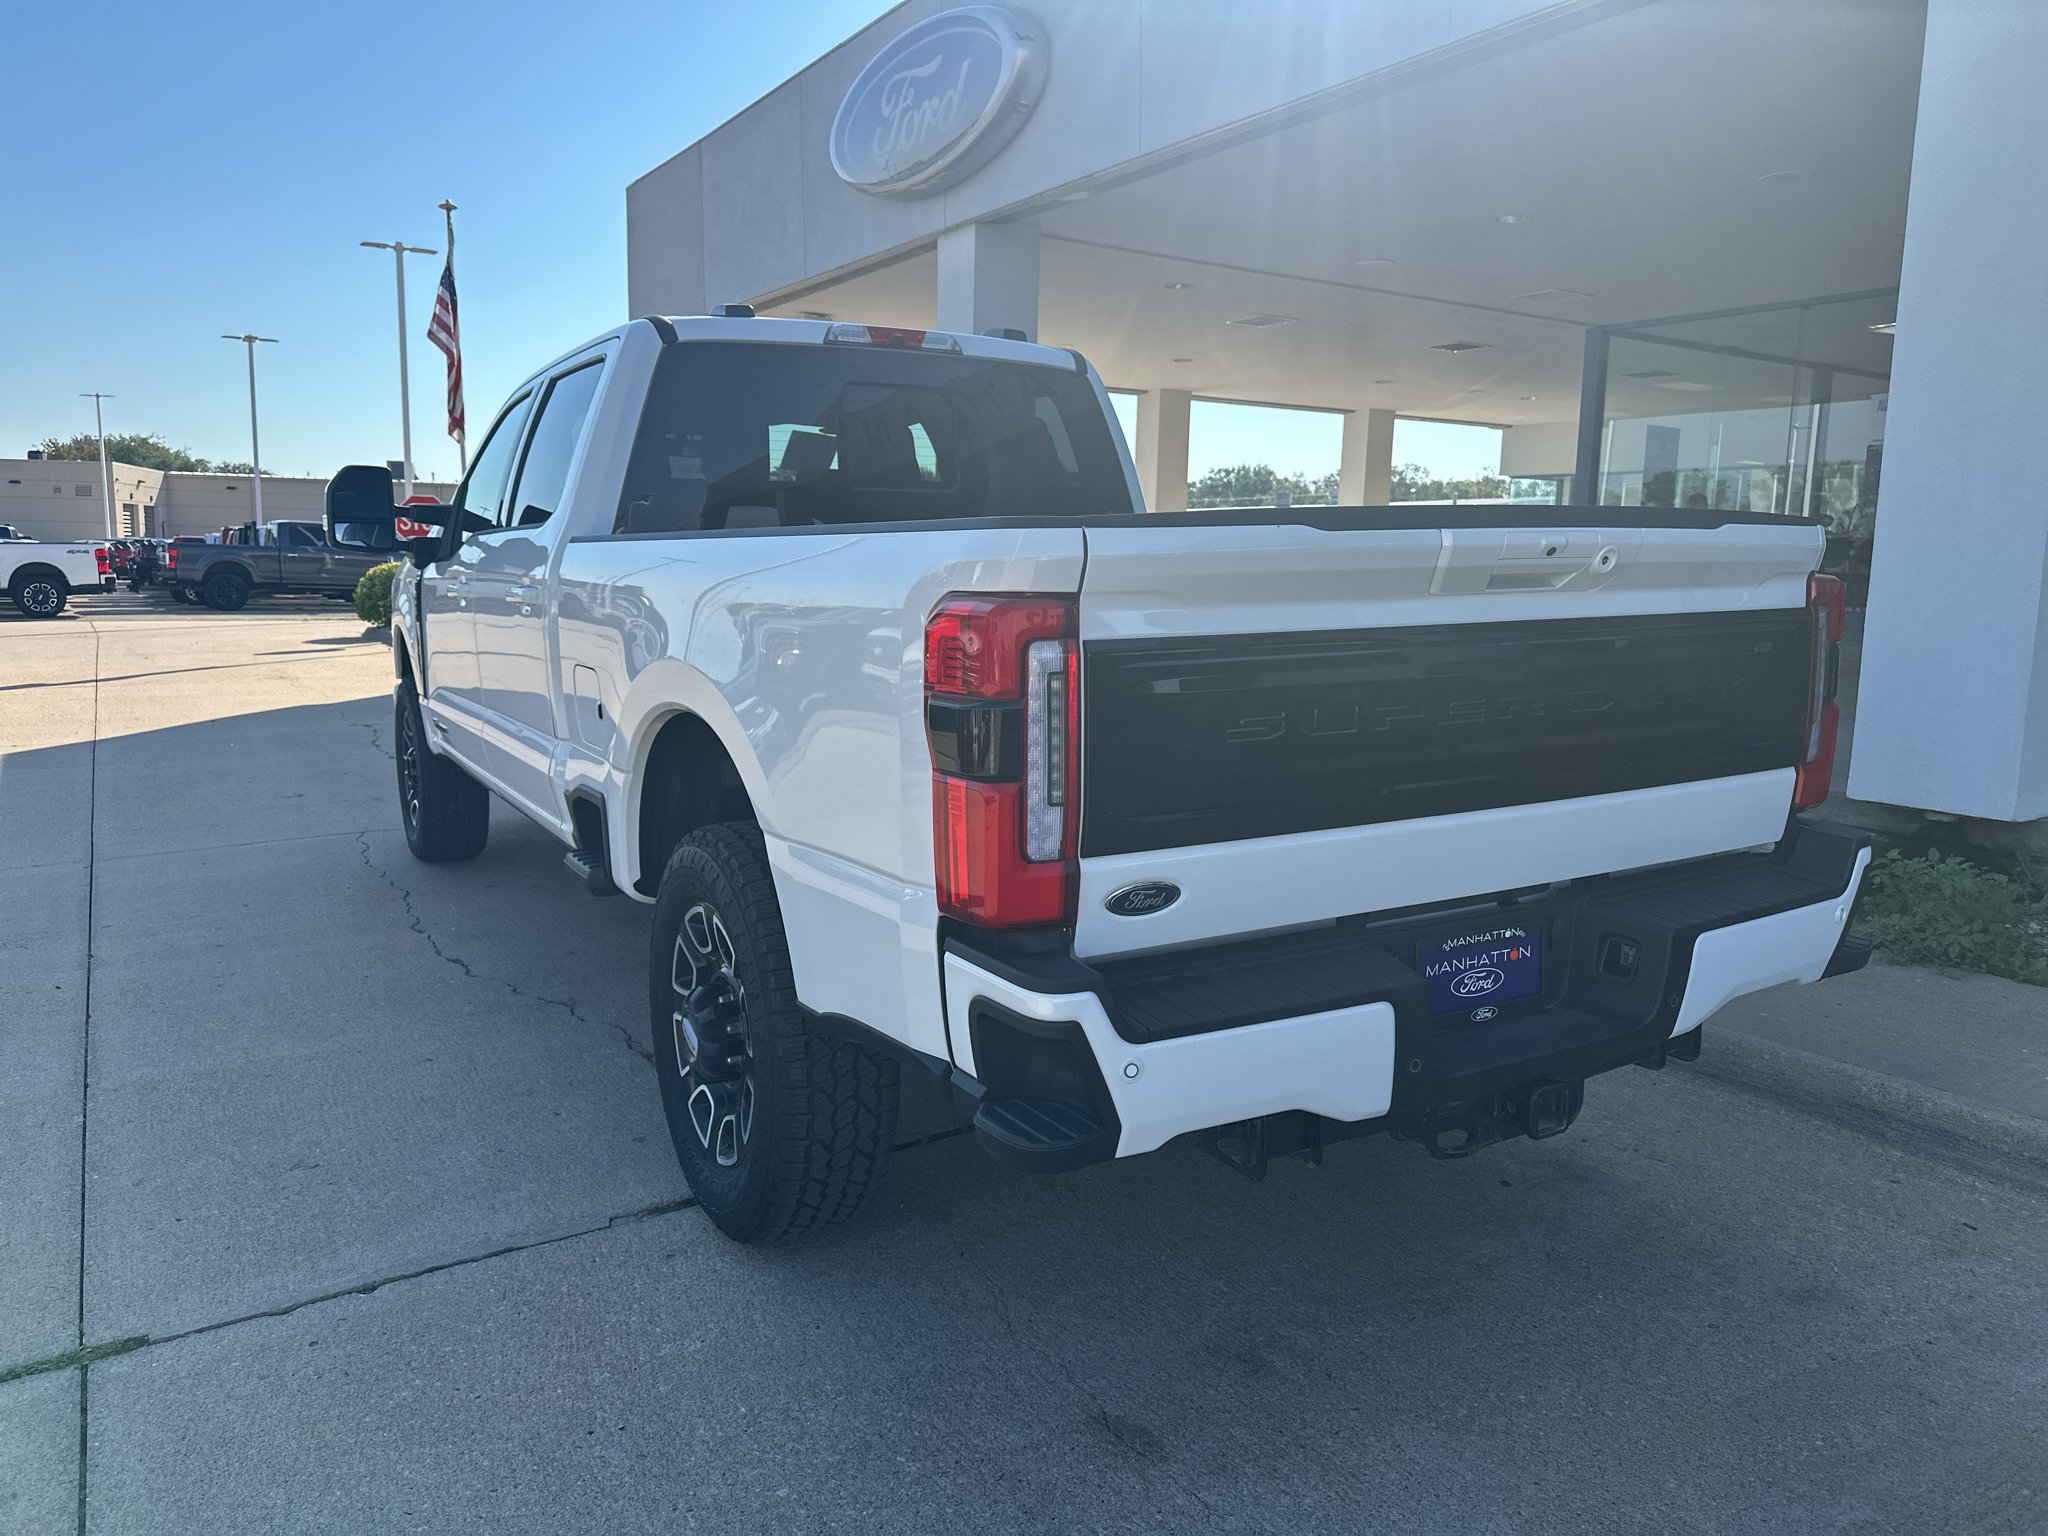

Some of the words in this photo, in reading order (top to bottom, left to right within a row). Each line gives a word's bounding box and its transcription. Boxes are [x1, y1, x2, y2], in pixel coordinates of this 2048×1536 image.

[872, 53, 971, 158] Ford
[1225, 694, 1545, 744] SUPER
[1124, 889, 1166, 909] Ford
[1460, 971, 1496, 994] Ford
